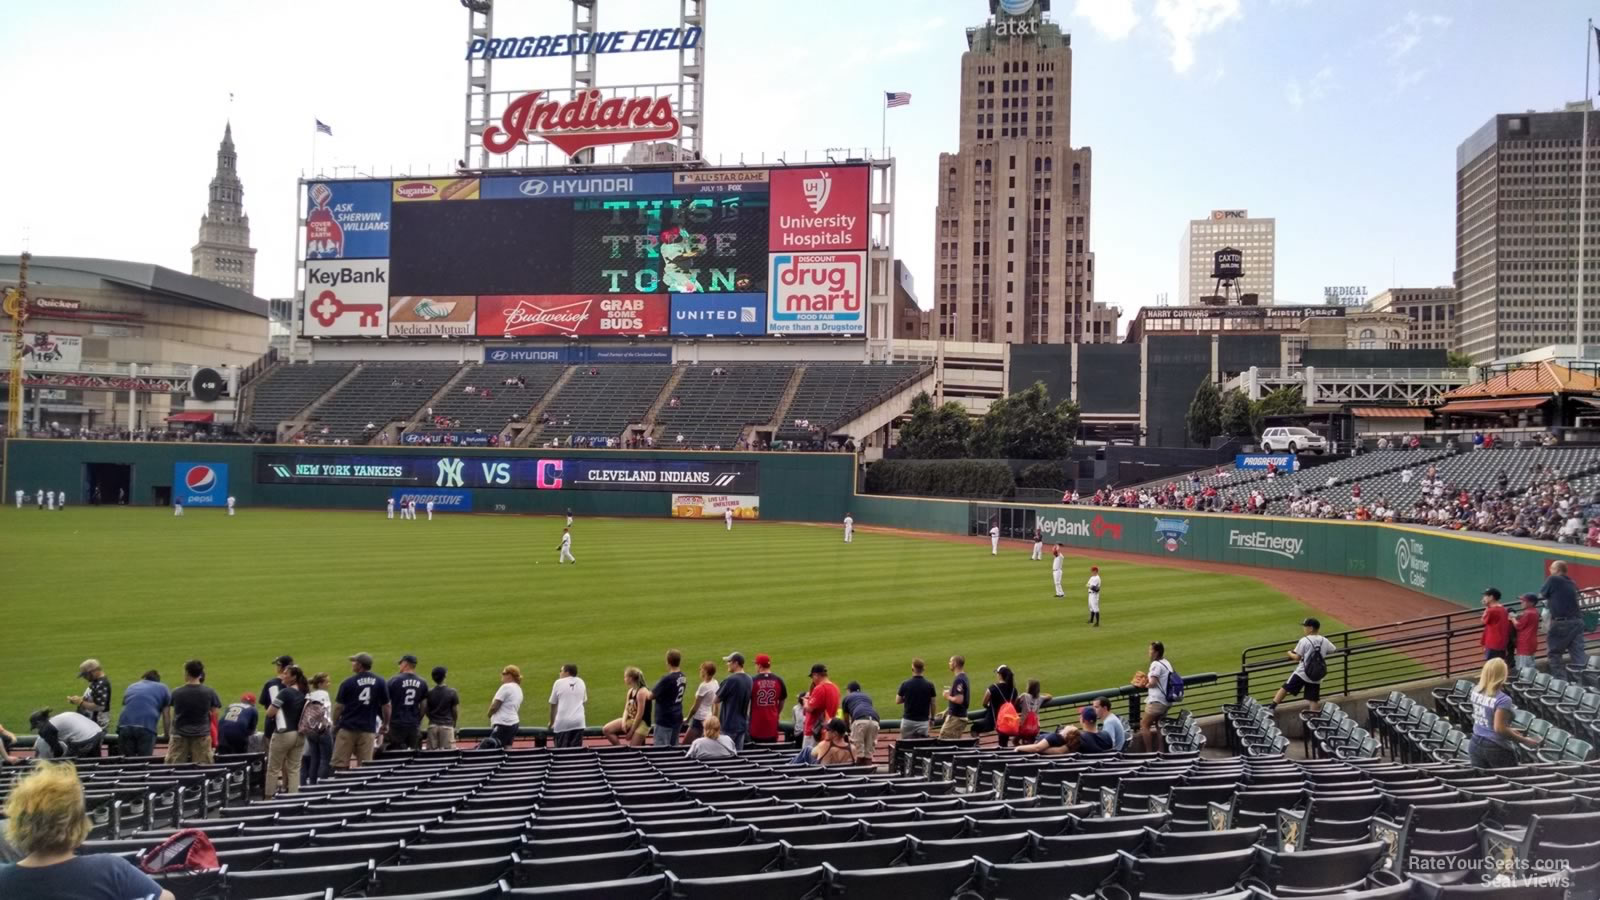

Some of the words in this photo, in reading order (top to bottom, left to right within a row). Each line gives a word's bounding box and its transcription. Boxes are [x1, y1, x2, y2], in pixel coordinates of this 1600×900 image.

[996, 16, 1037, 36] at&t
[465, 31, 627, 60] PROGRESSIVE
[631, 26, 702, 51] FIELD
[483, 89, 680, 157] Indians
[738, 172, 763, 180] GAME
[396, 184, 438, 197] Sugardale
[552, 178, 633, 193] HYUNDAI
[805, 182, 818, 192] UH
[334, 203, 354, 212] ASK
[603, 199, 714, 225] THIS
[1224, 210, 1244, 219] PNC
[338, 212, 382, 222] SHERWIN
[780, 214, 856, 230] University
[343, 221, 390, 231] WILLIAMS
[602, 233, 737, 258] TRBE
[783, 230, 852, 248] Hospitals
[798, 255, 836, 263] DISCOUNT
[308, 268, 385, 287] KeyBank
[781, 258, 846, 292] drug
[1324, 286, 1368, 296] MEDICAL
[36, 298, 79, 309] Quicken
[600, 299, 644, 311] GRAB
[786, 290, 858, 311] mart
[504, 307, 591, 325] Budweiser
[676, 310, 737, 320] UNITED
[1147, 310, 1171, 318] HARRY
[394, 323, 432, 335] Medical
[435, 323, 470, 335] Mutual
[600, 318, 643, 329] BUDS
[769, 323, 790, 331] More
[792, 323, 811, 331] than
[821, 323, 863, 332] Drugstore
[510, 351, 558, 360] HYUNDAI
[1243, 456, 1289, 466] PROGRESSIVE
[295, 464, 320, 476] NEW
[322, 464, 350, 477] YORK
[353, 465, 403, 478] YANKEES
[482, 462, 511, 484] VS
[588, 470, 656, 483] CLEVELAND
[660, 471, 710, 484] INDIANS
[187, 494, 213, 505] pepsi
[400, 493, 463, 505] PROGRESSIVE
[1035, 514, 1090, 538] KeyBank
[1228, 529, 1303, 553] FirstEnergy
[1410, 538, 1424, 555] Time
[1410, 554, 1430, 573] Warner
[1410, 570, 1426, 588] Cable
[358, 686, 371, 705] 4
[404, 688, 416, 706] 2
[757, 688, 777, 707] 22
